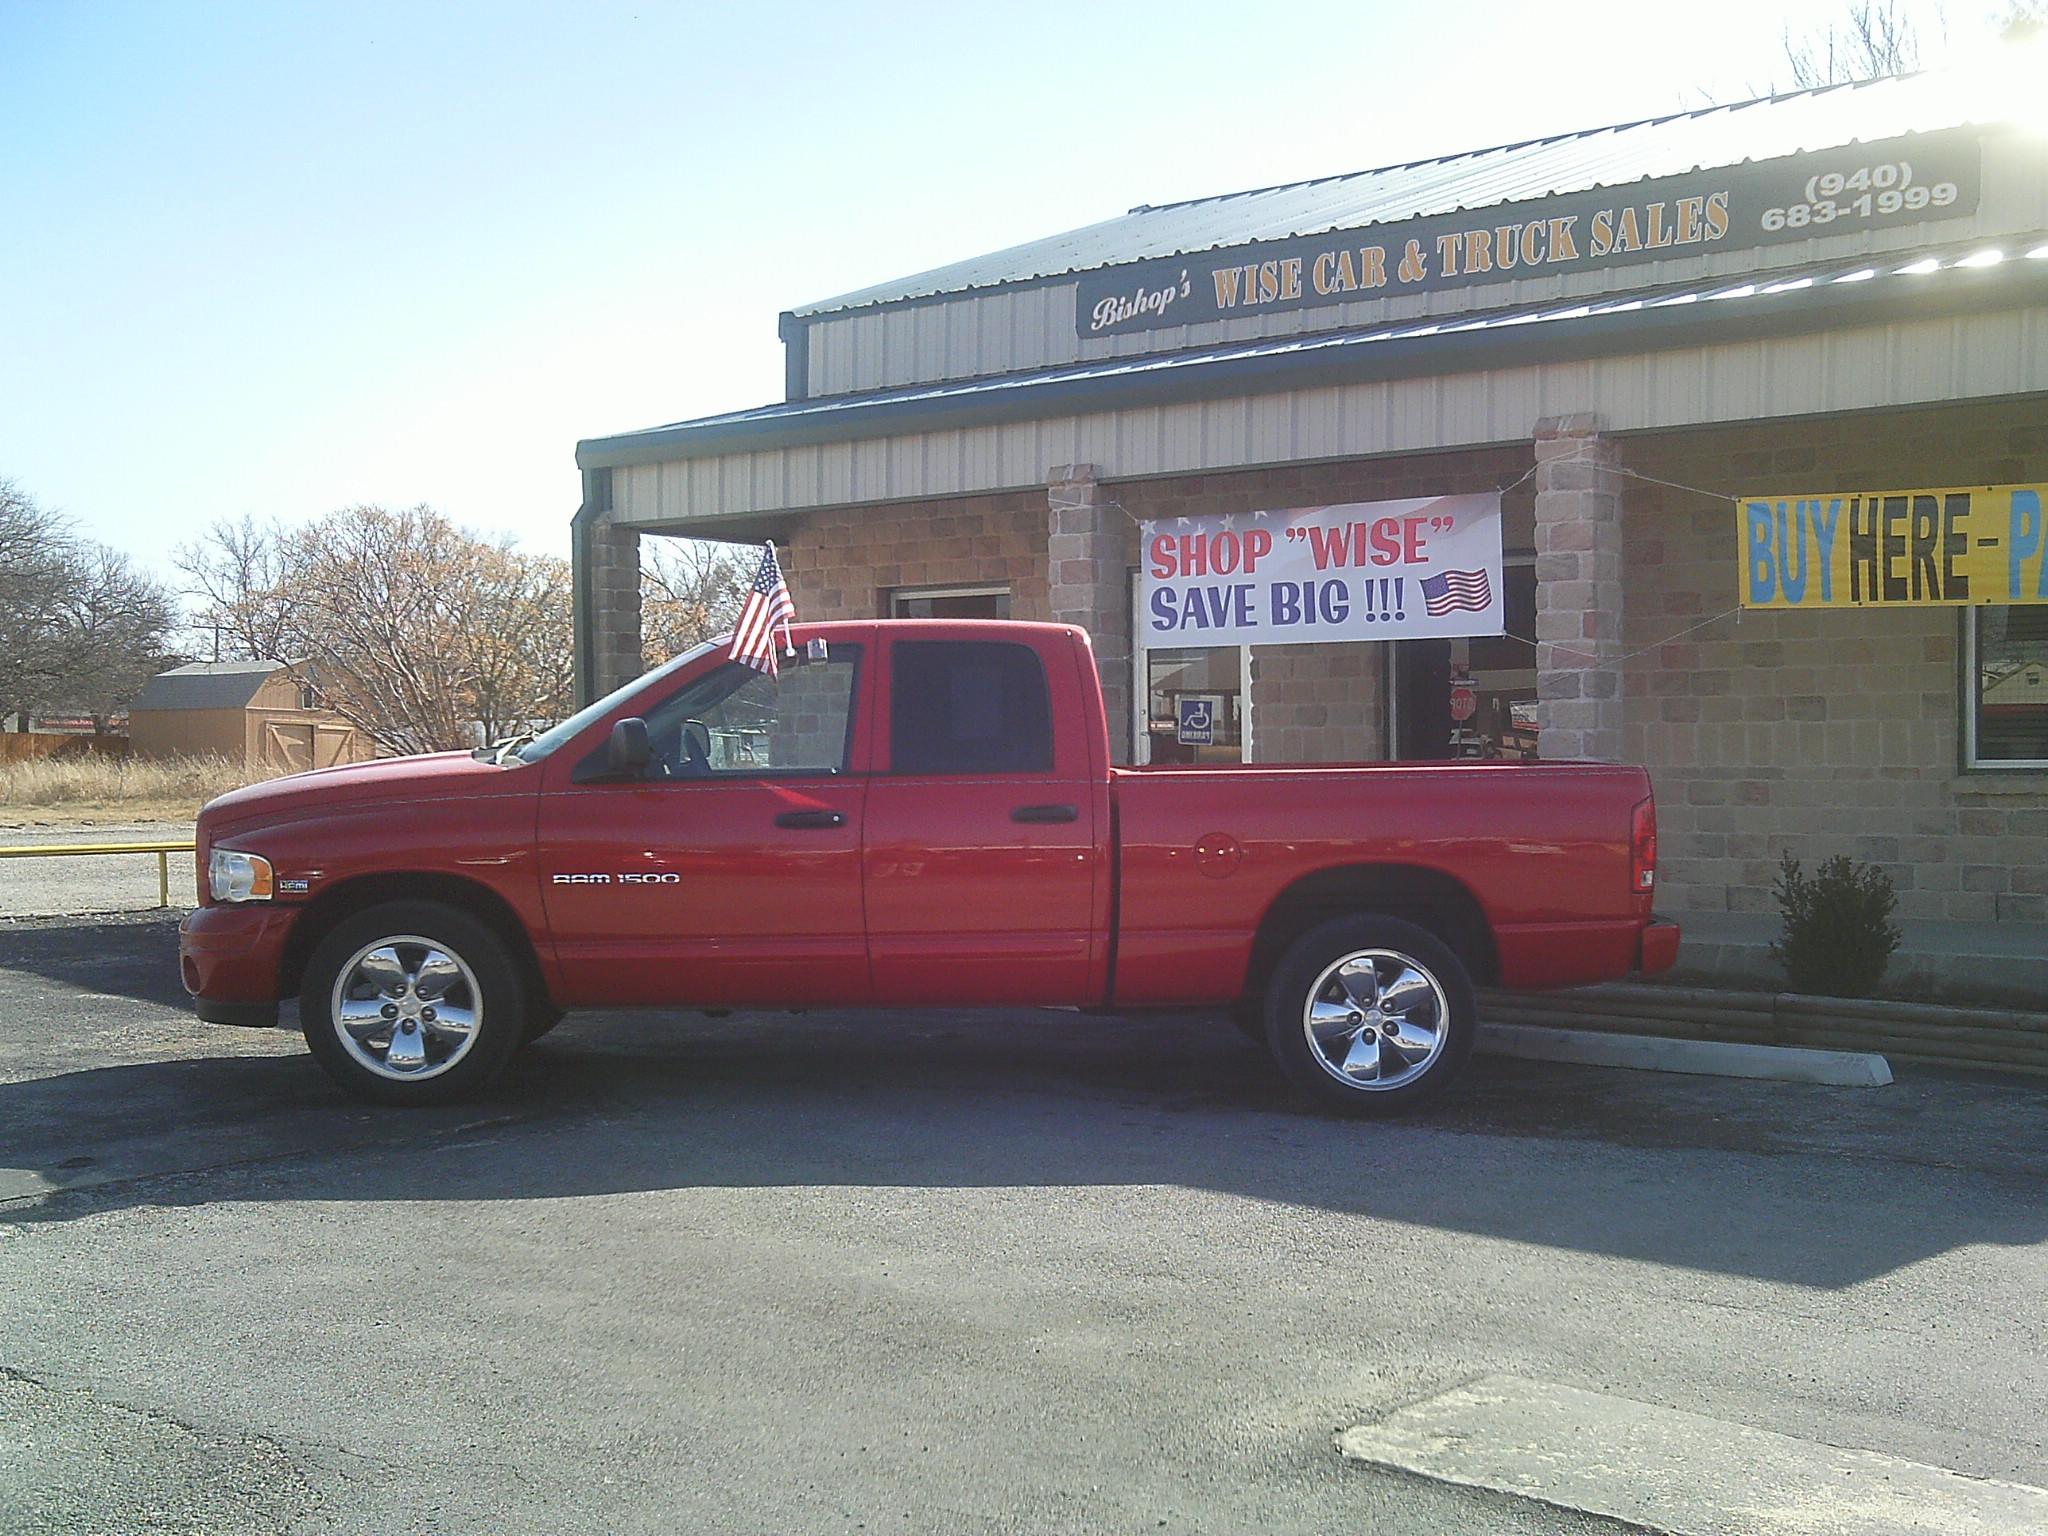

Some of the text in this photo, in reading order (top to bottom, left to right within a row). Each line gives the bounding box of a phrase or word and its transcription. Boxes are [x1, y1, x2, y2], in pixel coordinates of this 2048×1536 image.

[1761, 182, 1957, 232] 683-1999
[1805, 162, 1912, 203] (940)
[1090, 191, 1730, 331] Bishop's WISE CAR & TRUCK SALES
[1149, 528, 1273, 579] SHOP
[1747, 499, 1842, 604] BUY
[1150, 583, 1258, 631] SAVE
[1270, 578, 1350, 626] BIG
[617, 873, 681, 884] 1500
